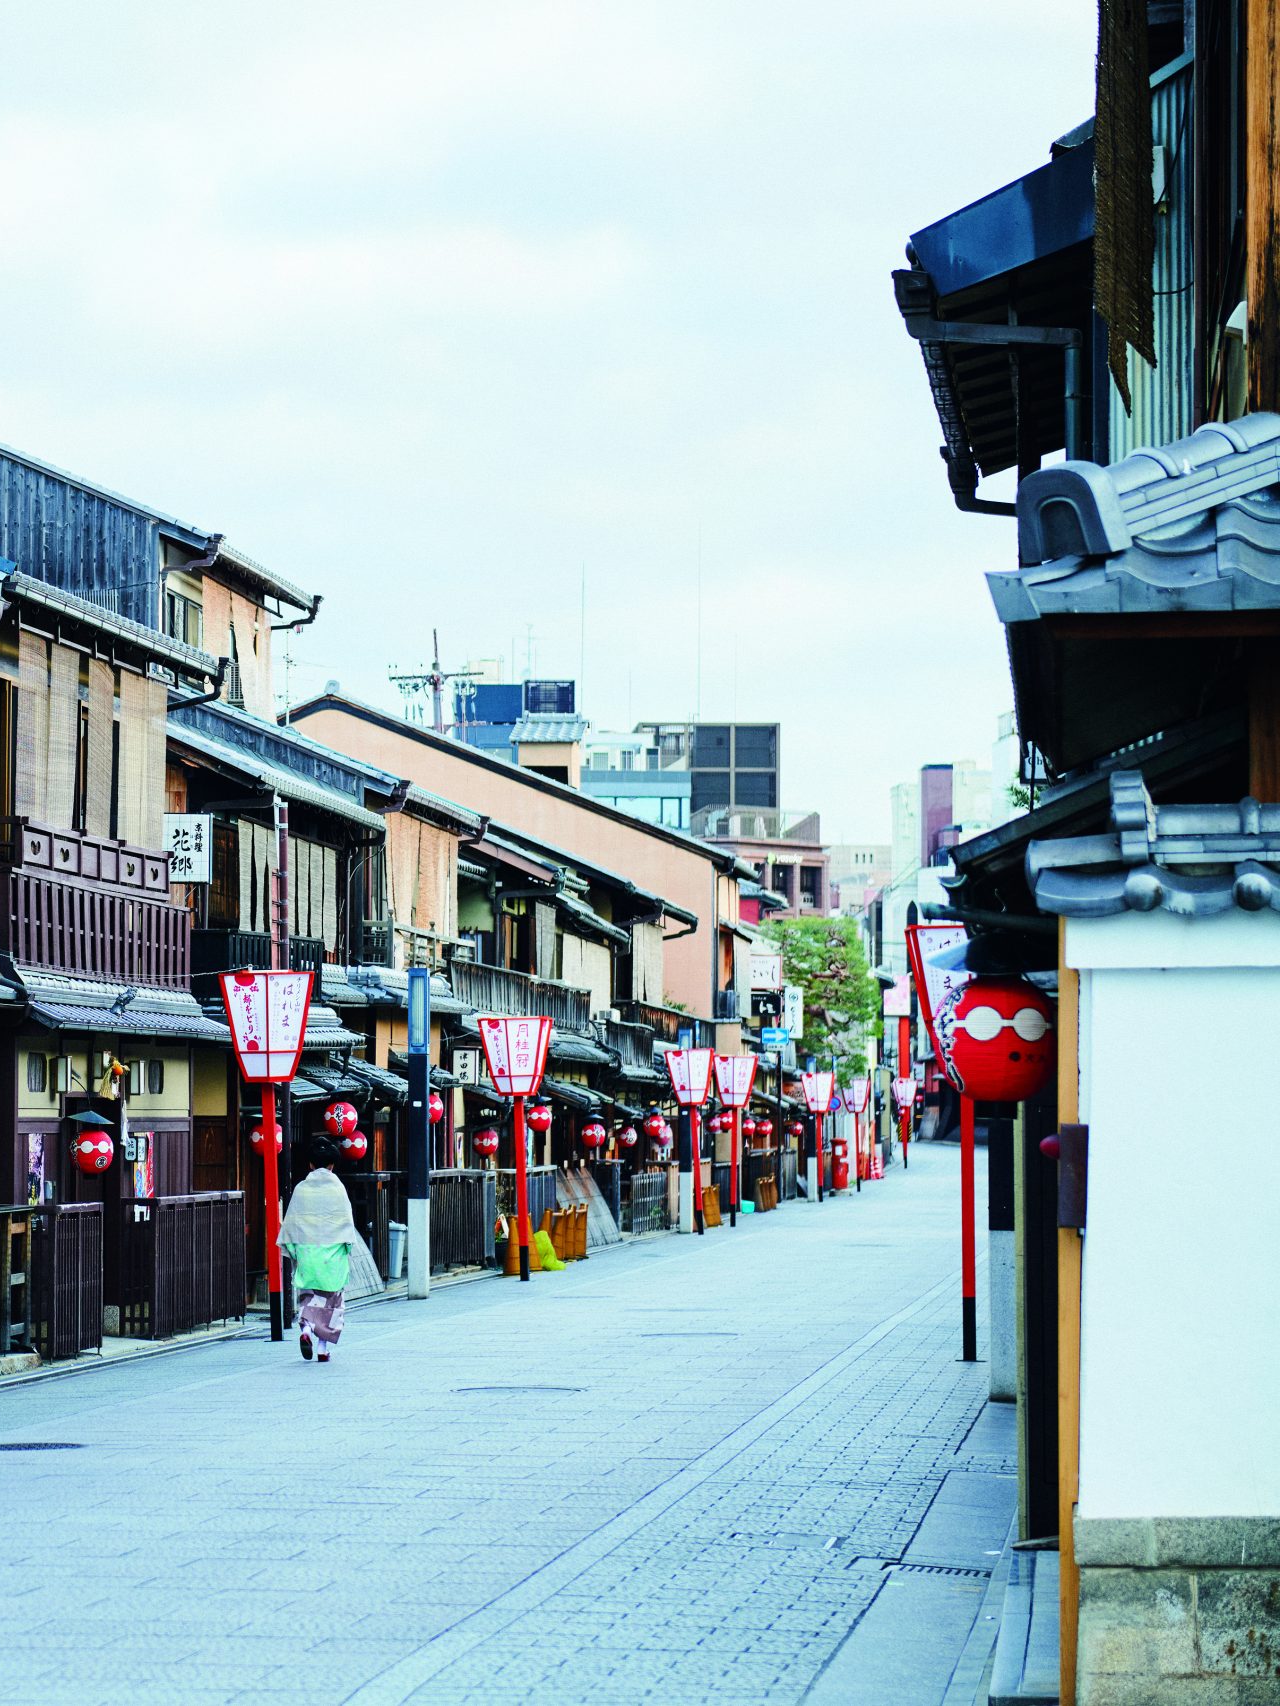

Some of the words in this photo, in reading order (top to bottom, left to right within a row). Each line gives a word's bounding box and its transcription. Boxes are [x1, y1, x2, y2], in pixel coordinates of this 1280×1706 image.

[170, 829, 192, 877] 花郷
[195, 823, 203, 852] 京料理
[282, 984, 293, 1027] はれま
[515, 1023, 530, 1068] 月桂冠
